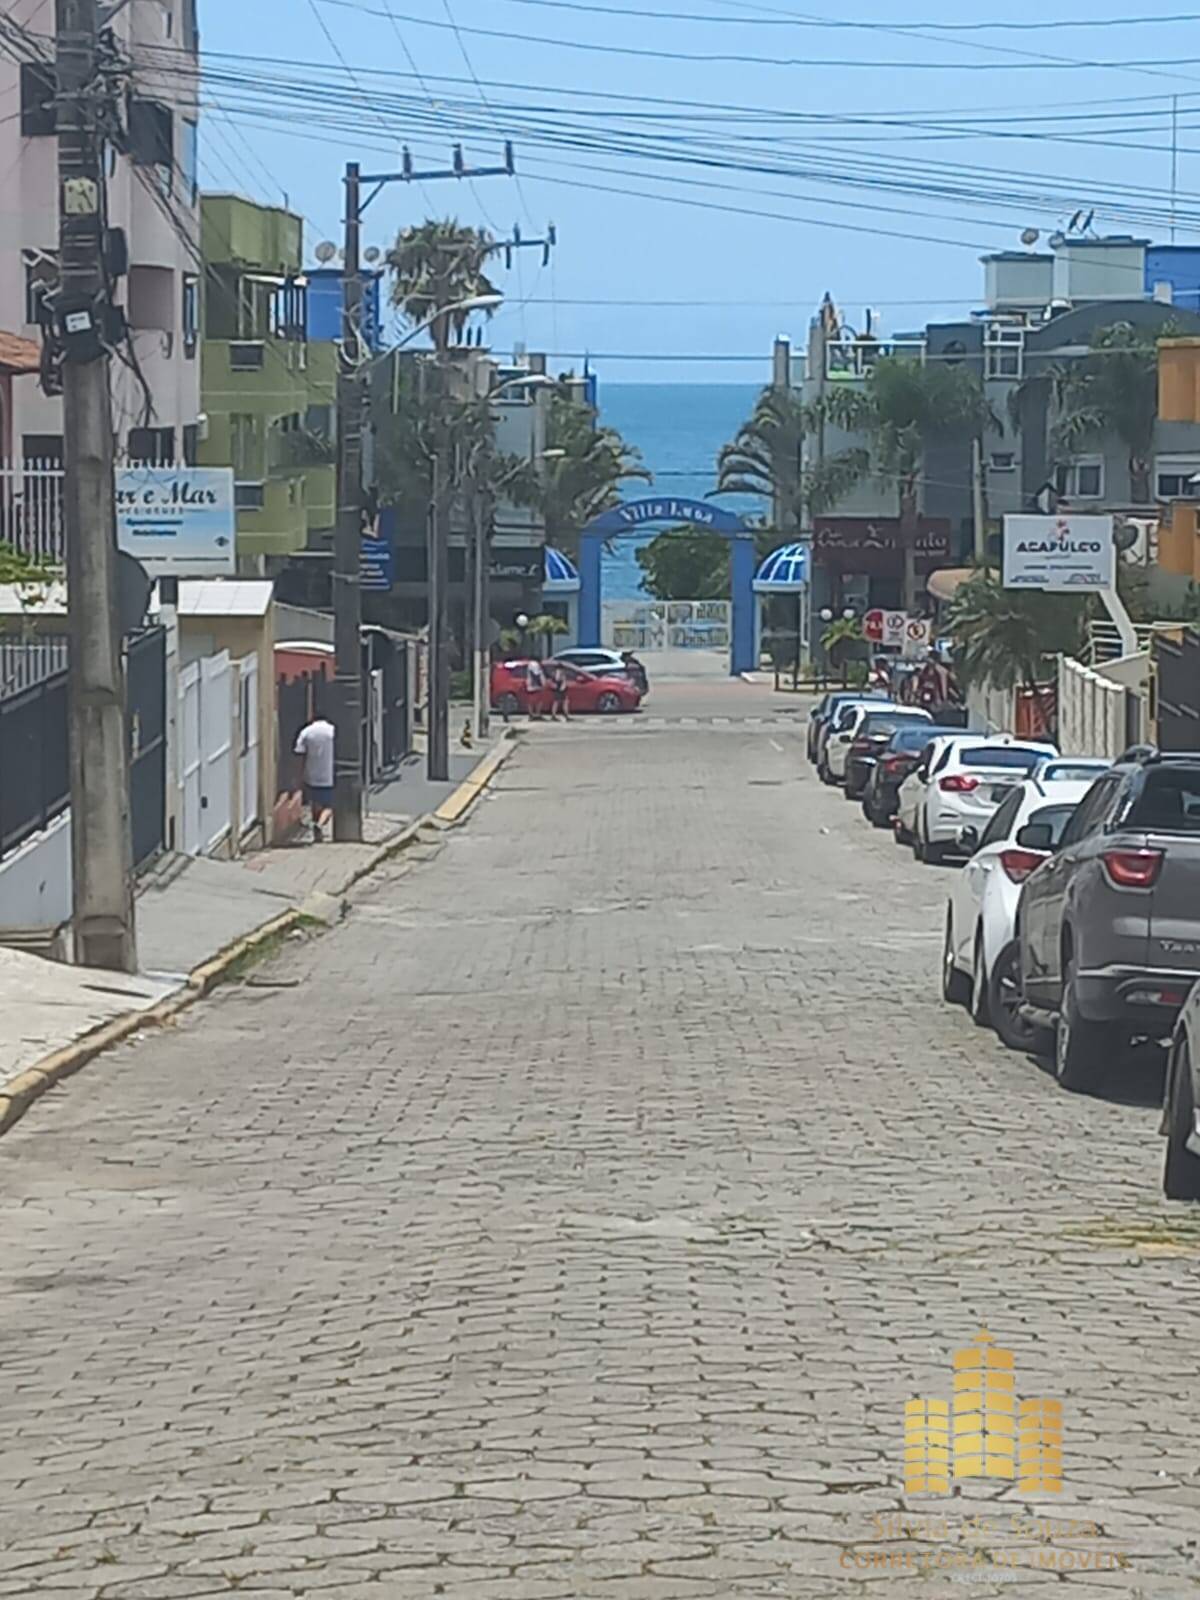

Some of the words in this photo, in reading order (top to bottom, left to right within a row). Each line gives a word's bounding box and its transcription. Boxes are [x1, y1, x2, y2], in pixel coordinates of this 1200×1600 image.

[143, 489, 154, 504] e
[161, 481, 217, 504] Mar
[1016, 541, 1102, 552] ACAPULCO
